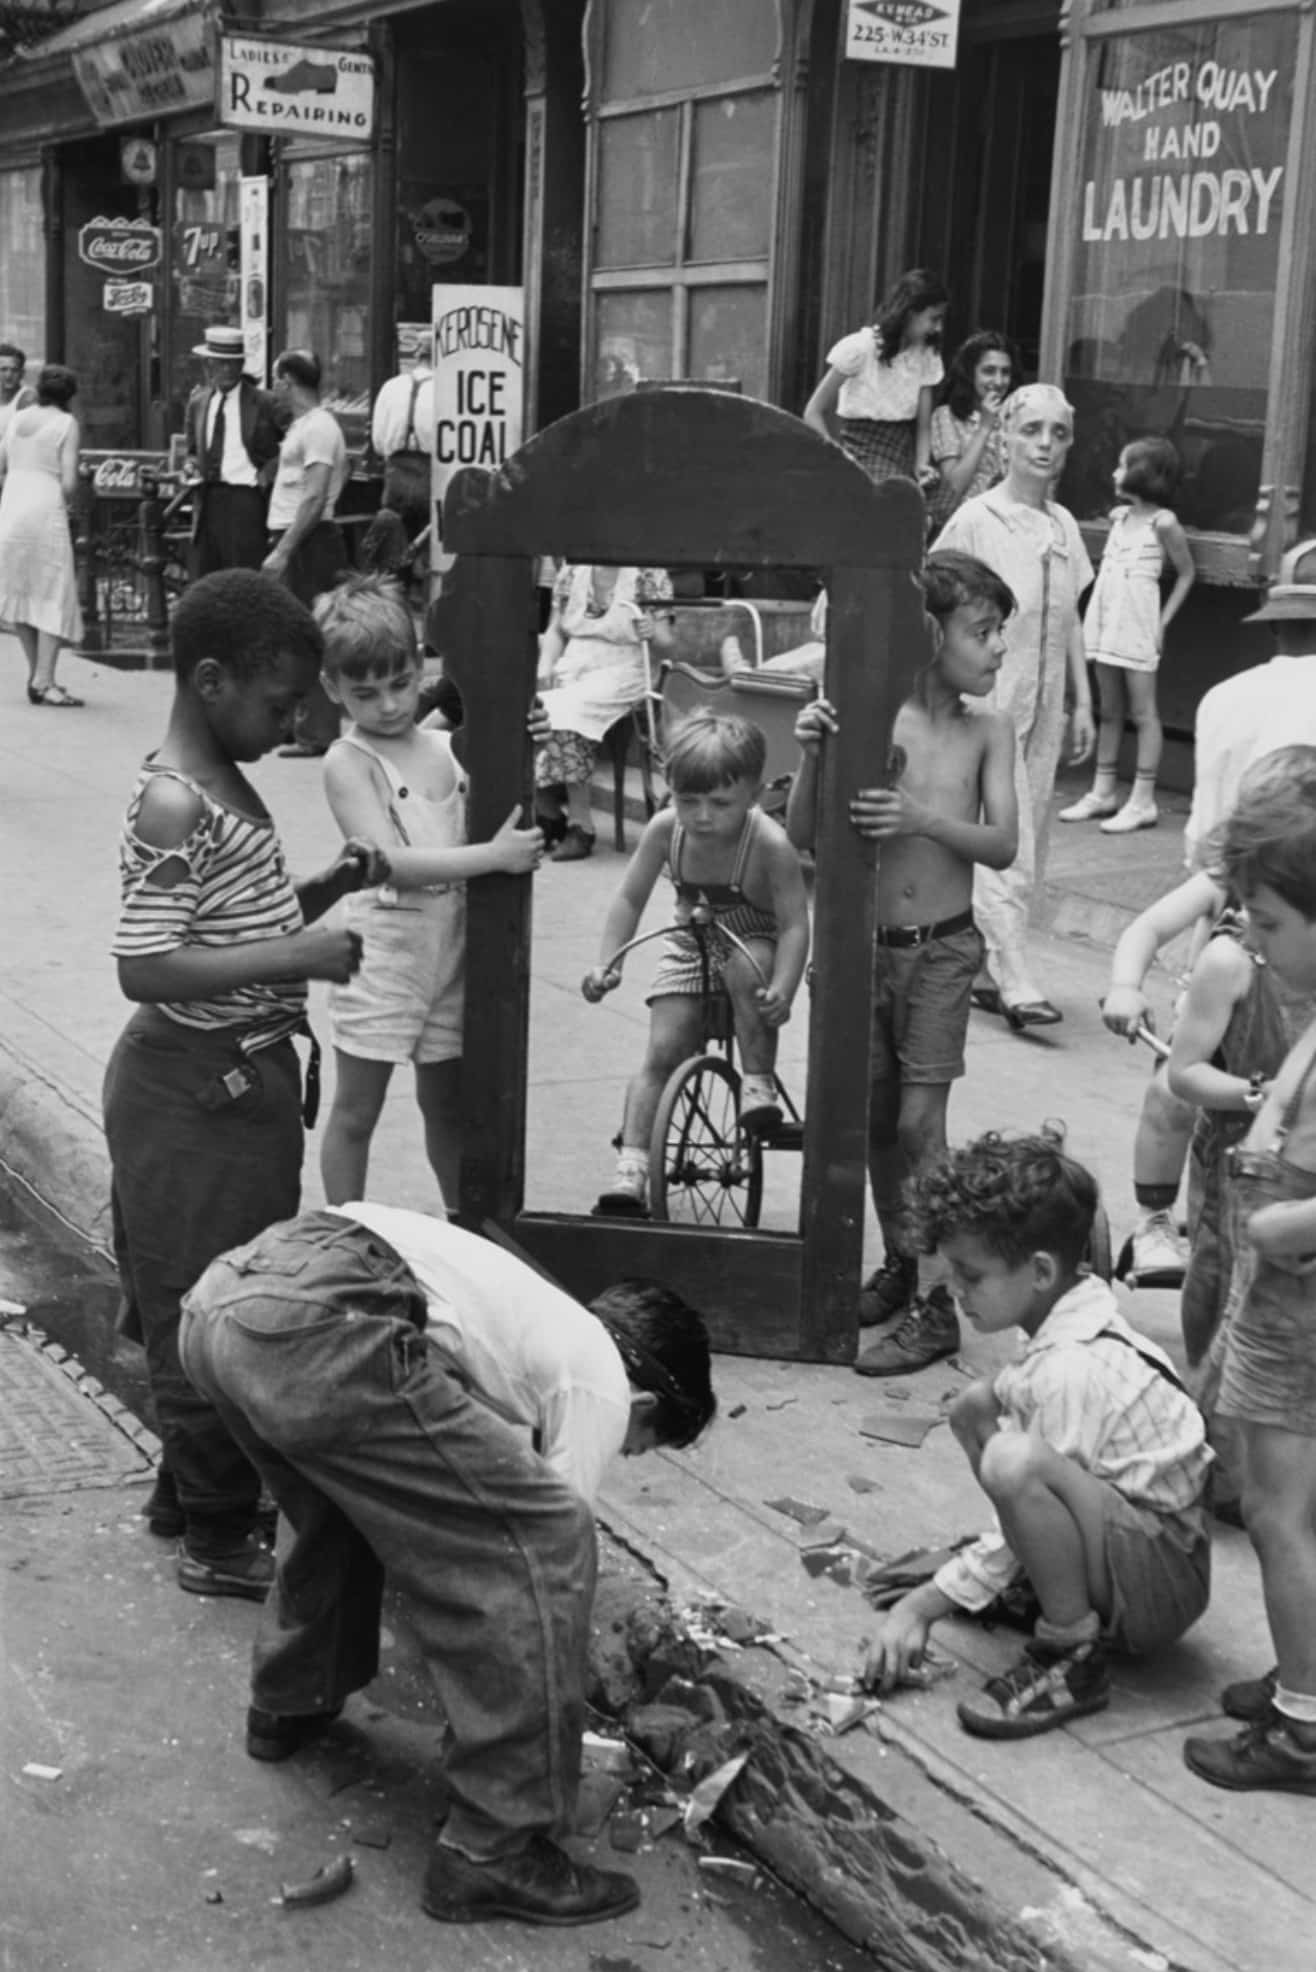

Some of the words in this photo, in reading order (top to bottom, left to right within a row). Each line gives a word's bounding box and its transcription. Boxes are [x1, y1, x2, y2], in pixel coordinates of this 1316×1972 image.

[231, 72, 367, 127] REPAIRING
[1102, 62, 1190, 126] WALTER
[1197, 61, 1278, 112] QUAY
[1144, 121, 1221, 161] HAND
[1083, 166, 1284, 241] LAUNDRY
[434, 305, 523, 368] KEROSENE
[457, 371, 506, 416] ICE
